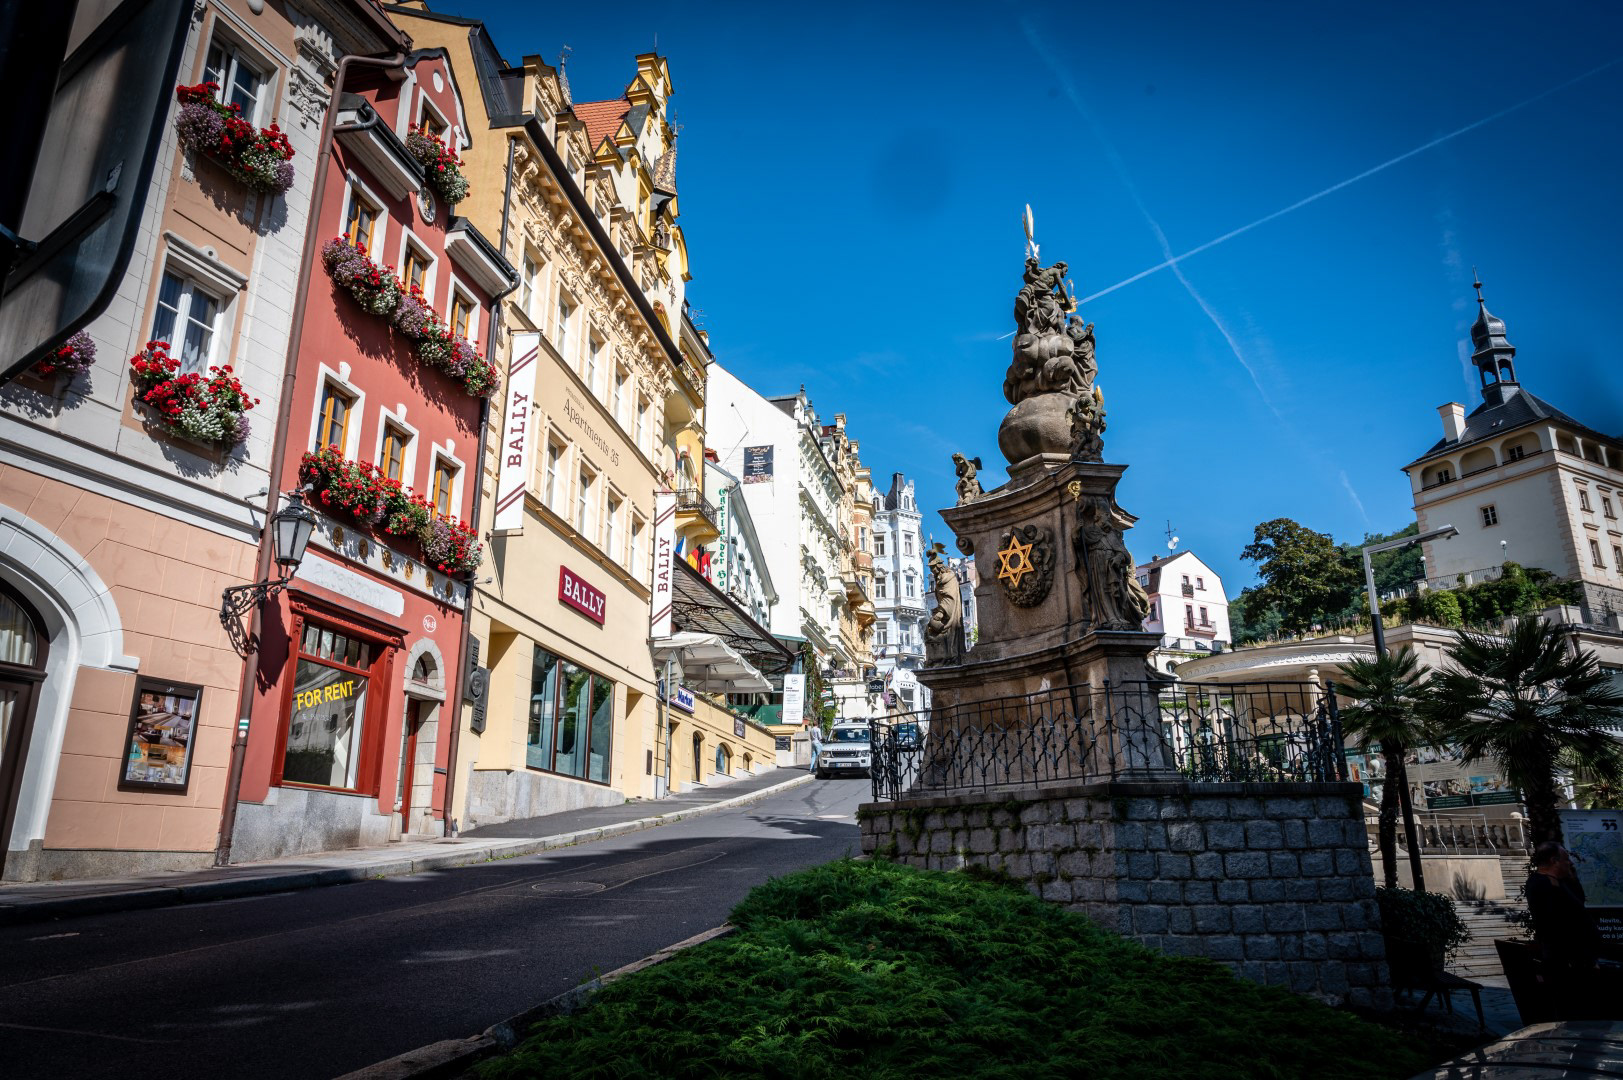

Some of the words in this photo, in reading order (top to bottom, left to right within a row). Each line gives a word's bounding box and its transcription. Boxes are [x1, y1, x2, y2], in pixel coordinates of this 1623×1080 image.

[506, 390, 528, 468] BALLY
[563, 398, 609, 456] Apartments
[610, 448, 619, 467] 35
[657, 536, 670, 593] BALLY
[562, 574, 605, 617] BALLY
[296, 688, 323, 711] FOR
[324, 680, 354, 703] RENT
